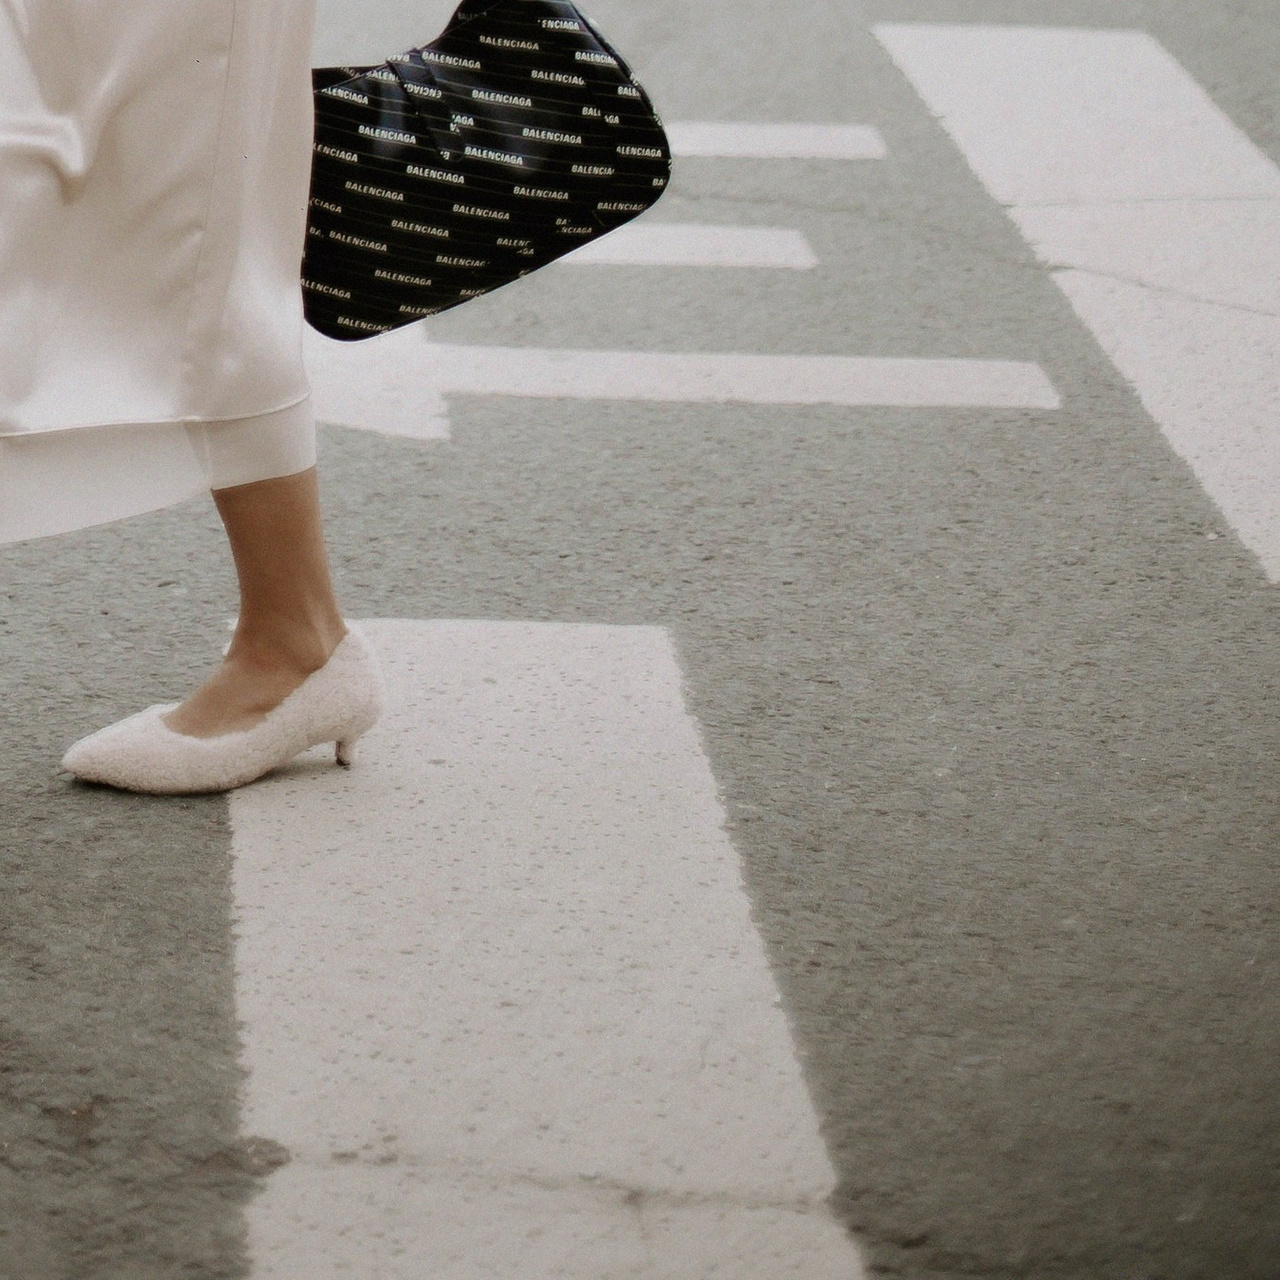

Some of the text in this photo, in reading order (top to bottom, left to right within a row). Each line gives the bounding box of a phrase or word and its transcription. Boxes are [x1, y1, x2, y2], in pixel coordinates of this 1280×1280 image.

[479, 35, 540, 51] BALENCIAGA
[422, 51, 481, 69] BALENCIAGA
[531, 69, 587, 85] BALENCIAG
[472, 89, 532, 107] BALENCIAGA
[358, 124, 417, 144] BALENCIAGA
[522, 127, 582, 144] BALENCIAGA
[313, 142, 358, 163] LENCIAGA
[464, 146, 523, 166] BALENCIAGA
[406, 164, 465, 184] BALENCIAGA
[571, 164, 615, 176] BALENCIA
[345, 181, 404, 201] BALENCIAGA
[513, 186, 569, 200] BALENCIAGA
[452, 203, 510, 220] BALENCIAGA
[391, 219, 450, 238] BALENCIAGA
[556, 226, 593, 234] NCIAGA
[329, 230, 388, 252] BALENCIAGA
[374, 269, 432, 286] BALENCIAGA
